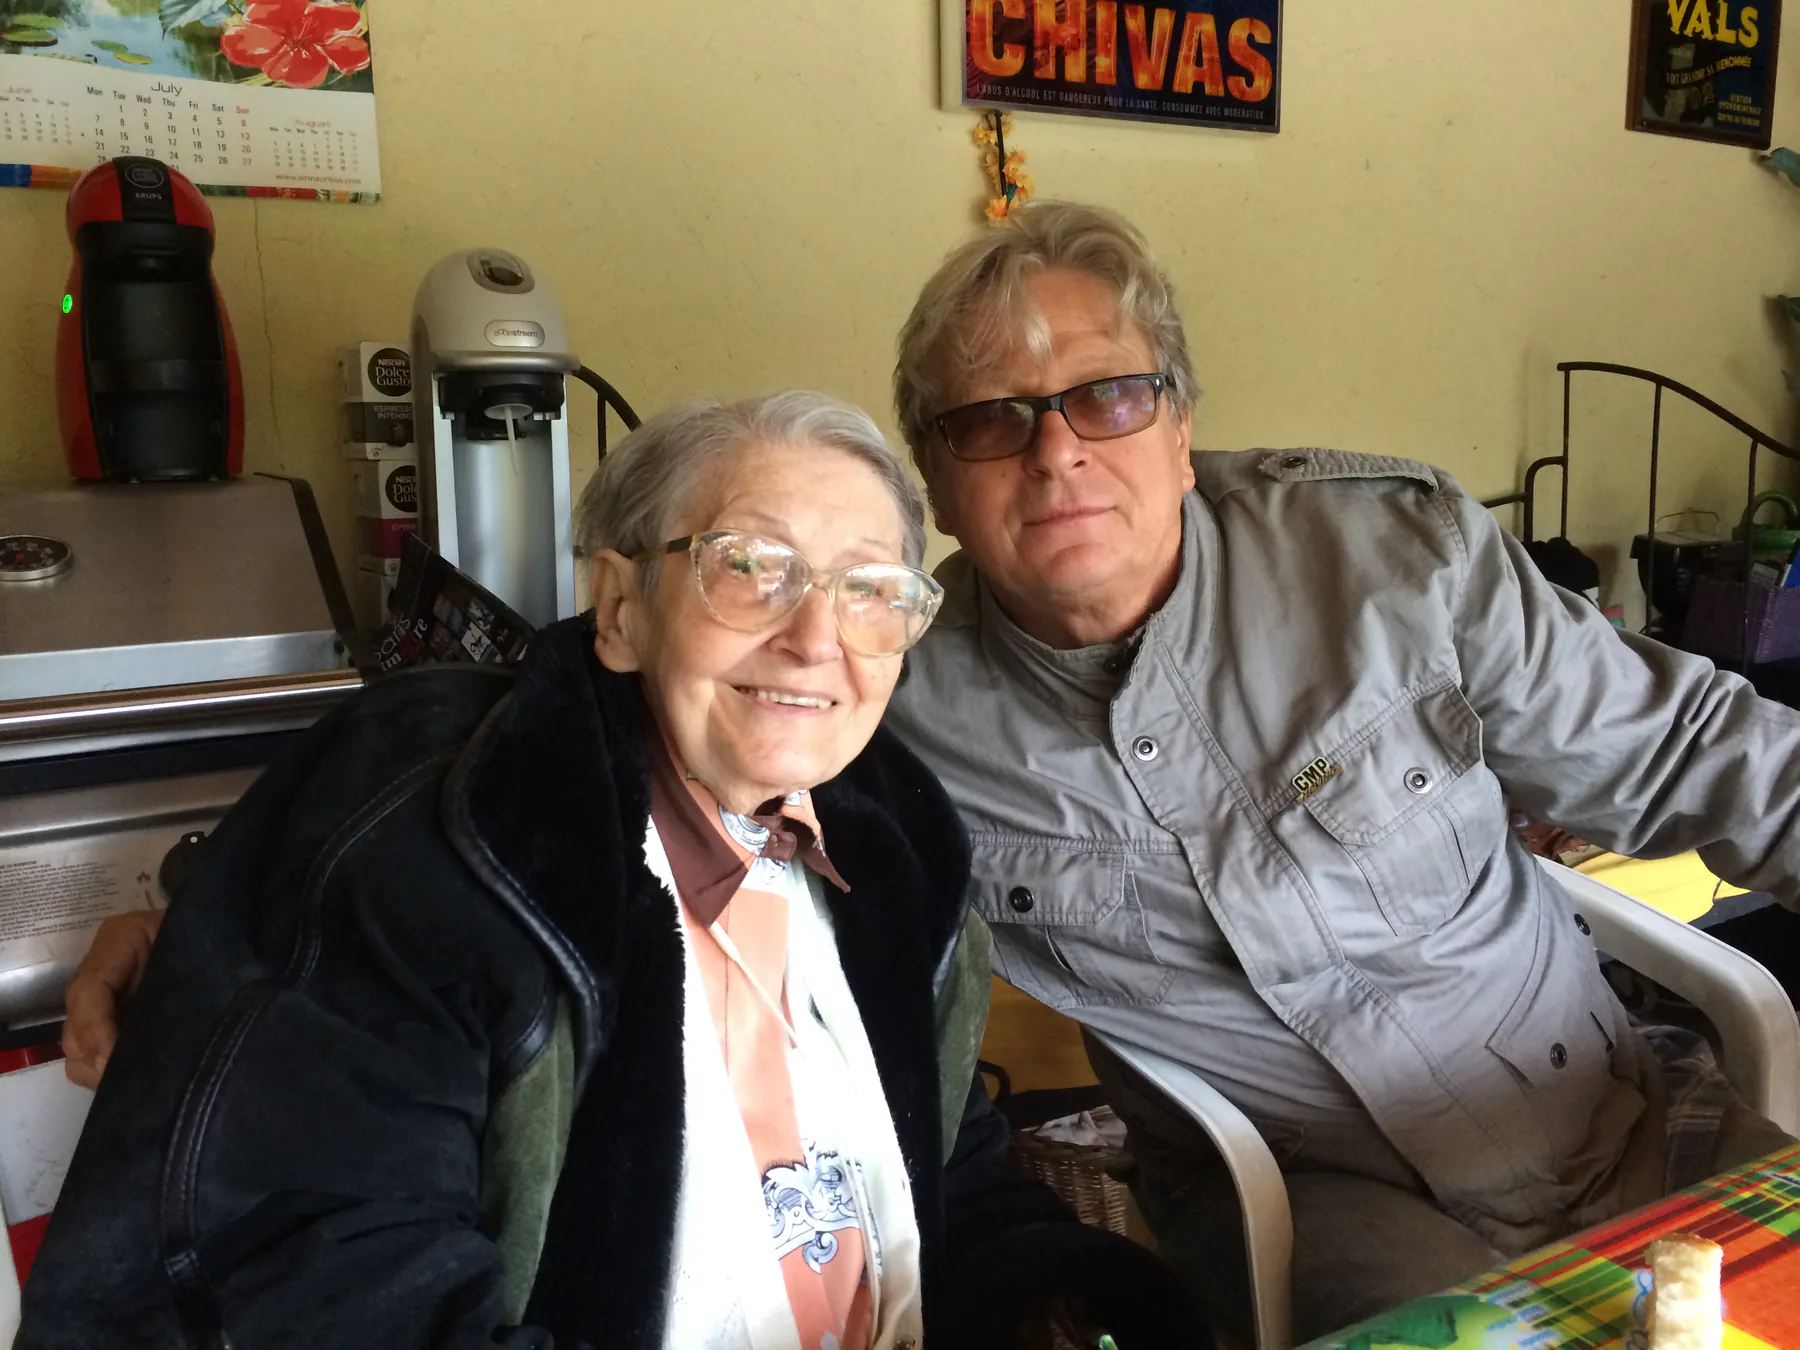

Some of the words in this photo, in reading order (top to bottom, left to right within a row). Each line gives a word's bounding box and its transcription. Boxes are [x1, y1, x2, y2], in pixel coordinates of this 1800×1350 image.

[1667, 0, 1759, 48] VALS
[968, 0, 1273, 102] CHIVAS
[150, 81, 183, 96] July
[87, 86, 103, 96] Mon
[113, 90, 126, 100] Tue
[136, 94, 152, 104] Wed
[162, 97, 176, 107] Thu
[189, 101, 199, 109] Fri
[212, 103, 224, 112] Sat
[236, 105, 249, 114] Sun
[976, 83, 1002, 96] L'ABUS
[1005, 86, 1040, 100] D'ALCOOL
[1043, 90, 1056, 100] EST
[1060, 92, 1101, 105] DANGEREUX
[1104, 96, 1123, 107] POUR
[1126, 98, 1135, 108] LA
[1162, 101, 1203, 114] CONSOMMEZ
[1205, 106, 1221, 116] AVEC
[142, 108, 148, 117] 2
[167, 111, 173, 120] 3
[192, 114, 198, 122] 4
[216, 116, 222, 125] 5
[144, 121, 150, 130] 9
[167, 125, 177, 133] 10
[192, 127, 200, 136] 11
[216, 130, 225, 138] 12
[241, 132, 250, 140] 13
[95, 128, 104, 136] 14
[119, 132, 129, 140] 15
[168, 138, 177, 147] 17
[193, 141, 202, 149] 18
[217, 143, 227, 152] 19
[241, 145, 251, 153] 20
[95, 141, 105, 150] 21
[120, 145, 130, 154] 22
[145, 148, 155, 157] 23
[169, 151, 179, 160] 24
[193, 154, 203, 163] 25
[218, 156, 228, 164] 26
[243, 158, 252, 166] 27
[135, 192, 162, 200] KRUPS
[375, 366, 410, 377] Dolce
[376, 375, 411, 386] Gusto
[392, 483, 417, 494] Dol
[394, 493, 417, 503] Gus
[1293, 757, 1327, 791] CMP
